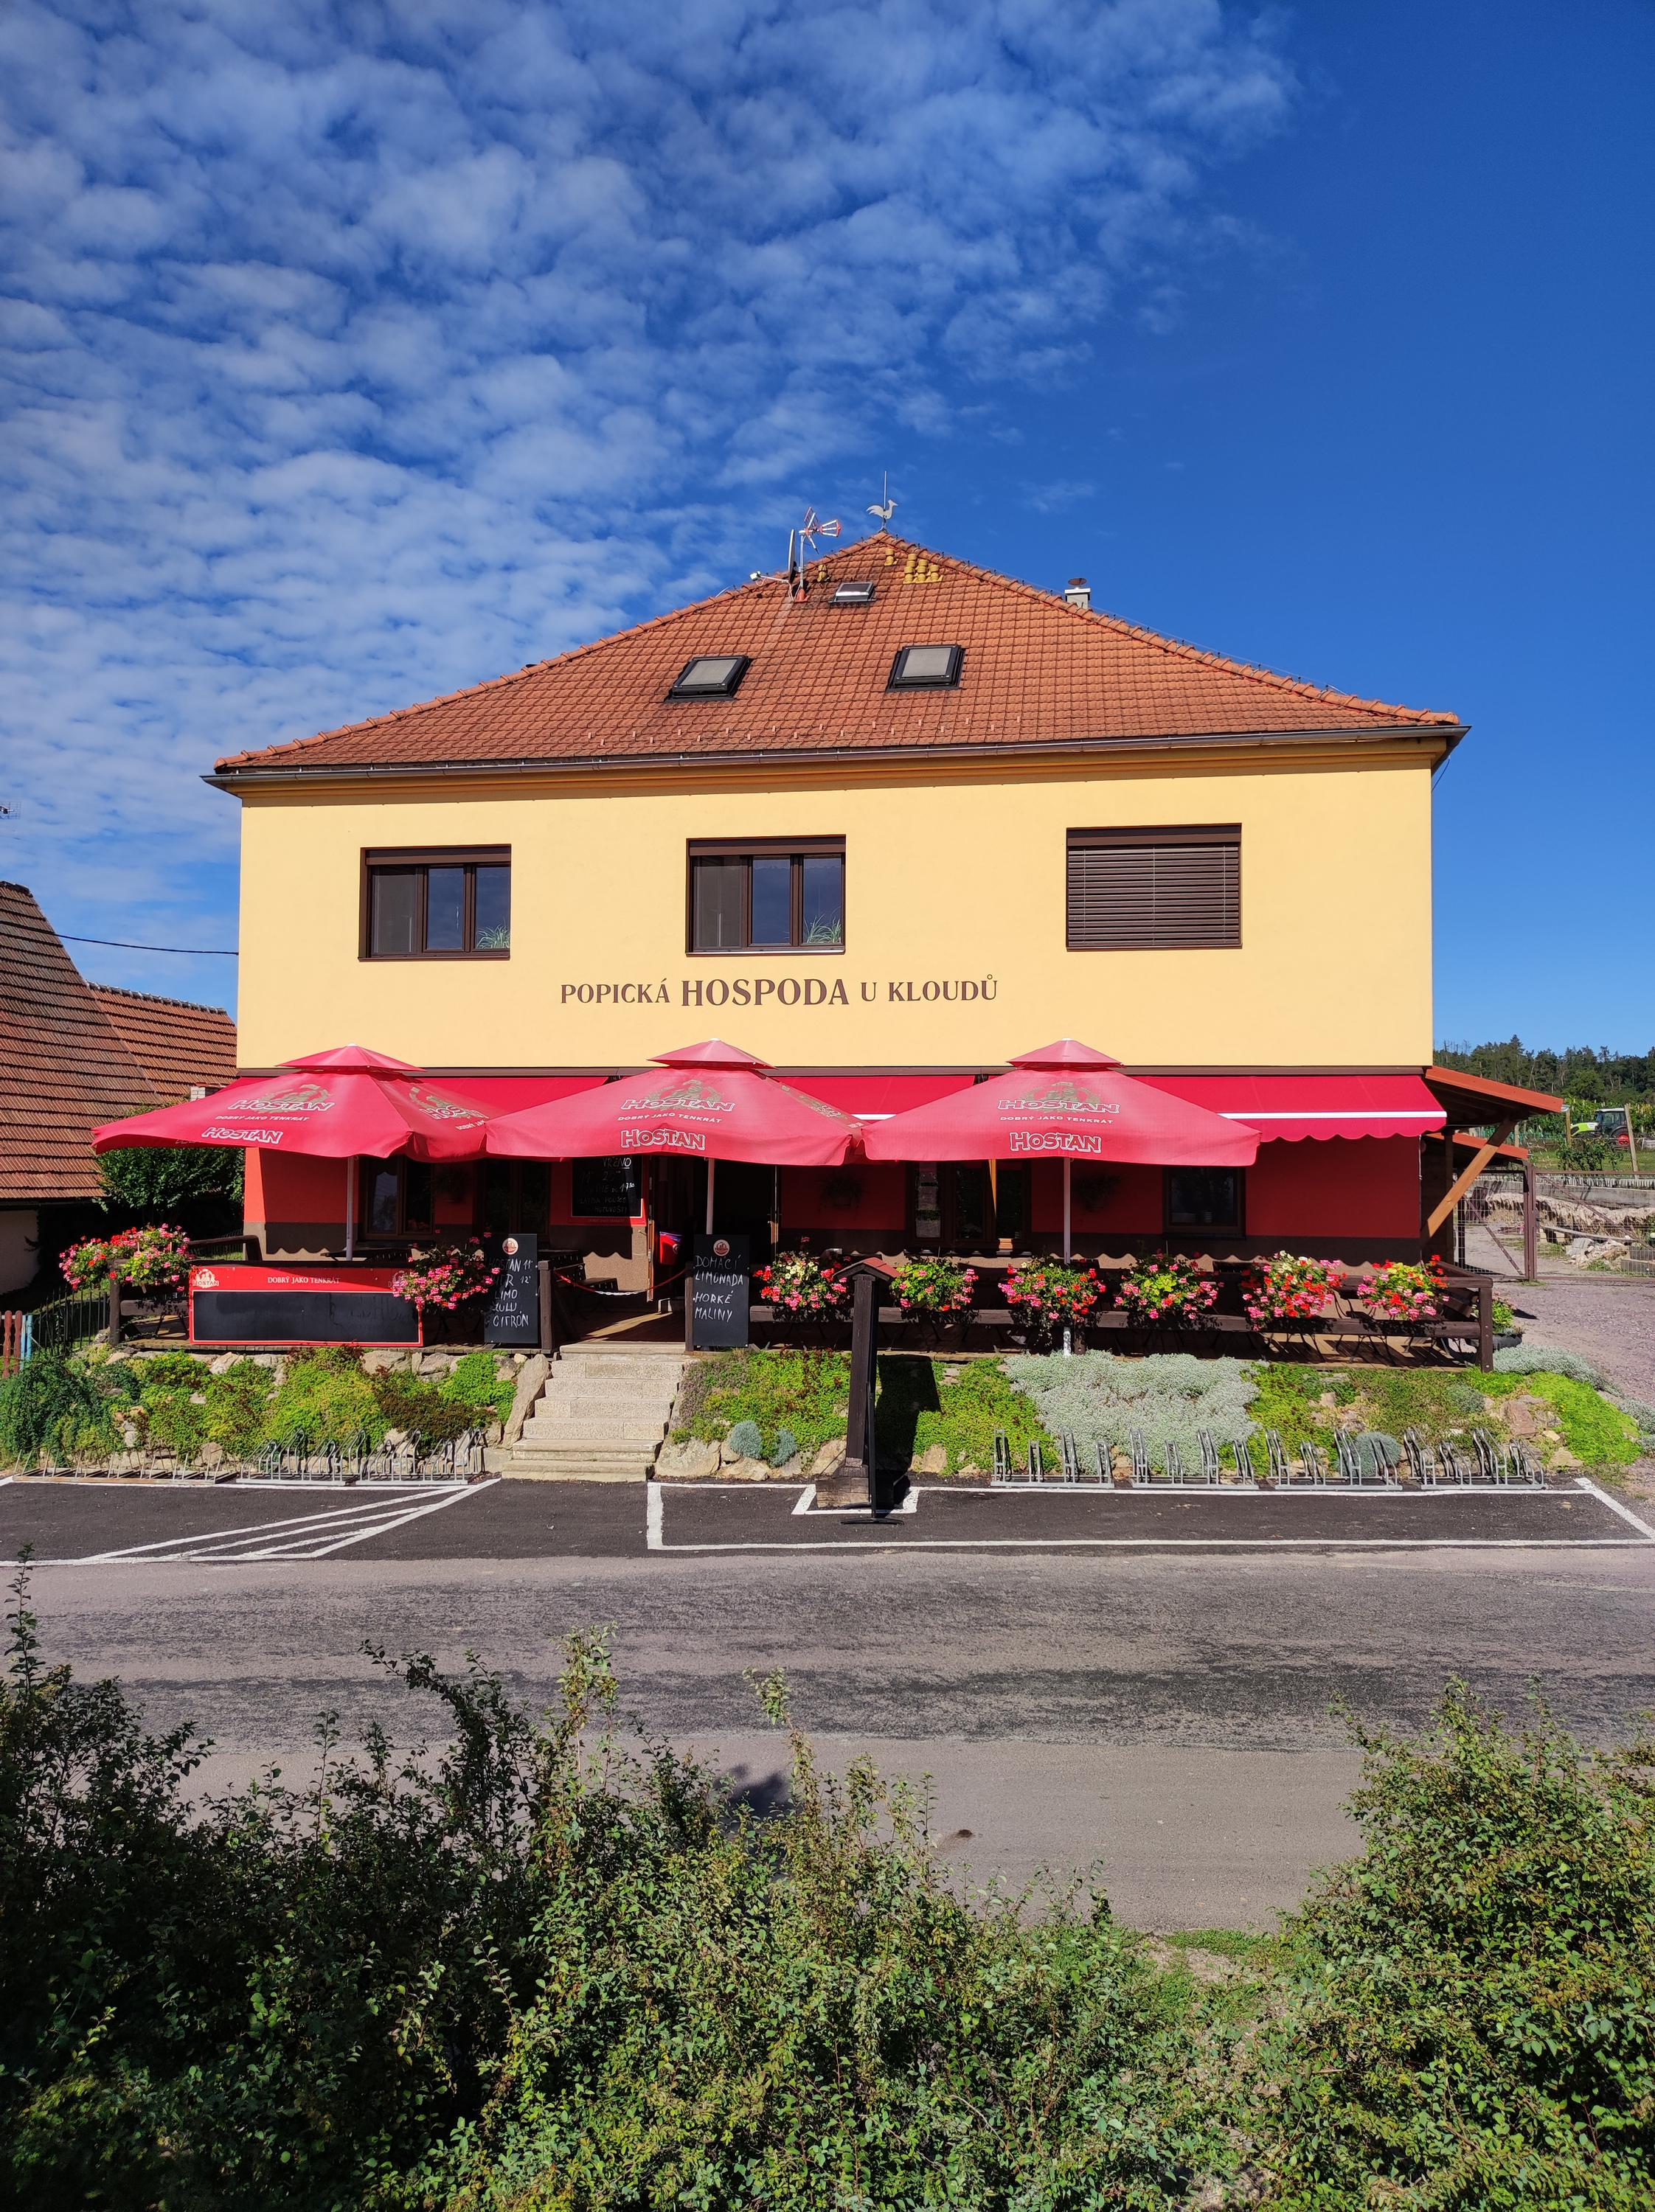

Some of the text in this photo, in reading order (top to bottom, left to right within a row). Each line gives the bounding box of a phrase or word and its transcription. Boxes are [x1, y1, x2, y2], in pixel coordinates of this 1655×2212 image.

[560, 973, 999, 1007] POPICKÁ HOSPODA U KLOUDŮ
[228, 1099, 335, 1112] HOSTAN
[621, 1097, 736, 1112] HOSTAN
[997, 1099, 1120, 1113] HOSTAN
[201, 1127, 283, 1144] HOSTAN
[621, 1128, 707, 1151] HOSTAN
[1009, 1131, 1102, 1154] HOSTAN
[268, 1276, 341, 1284] DOBRÝ JAKO TENKRÁT
[494, 1289, 518, 1301] LIMO
[695, 1290, 735, 1304] HORKÉ
[493, 1310, 530, 1329] CITRÓN
[694, 1307, 733, 1324] MALINY
